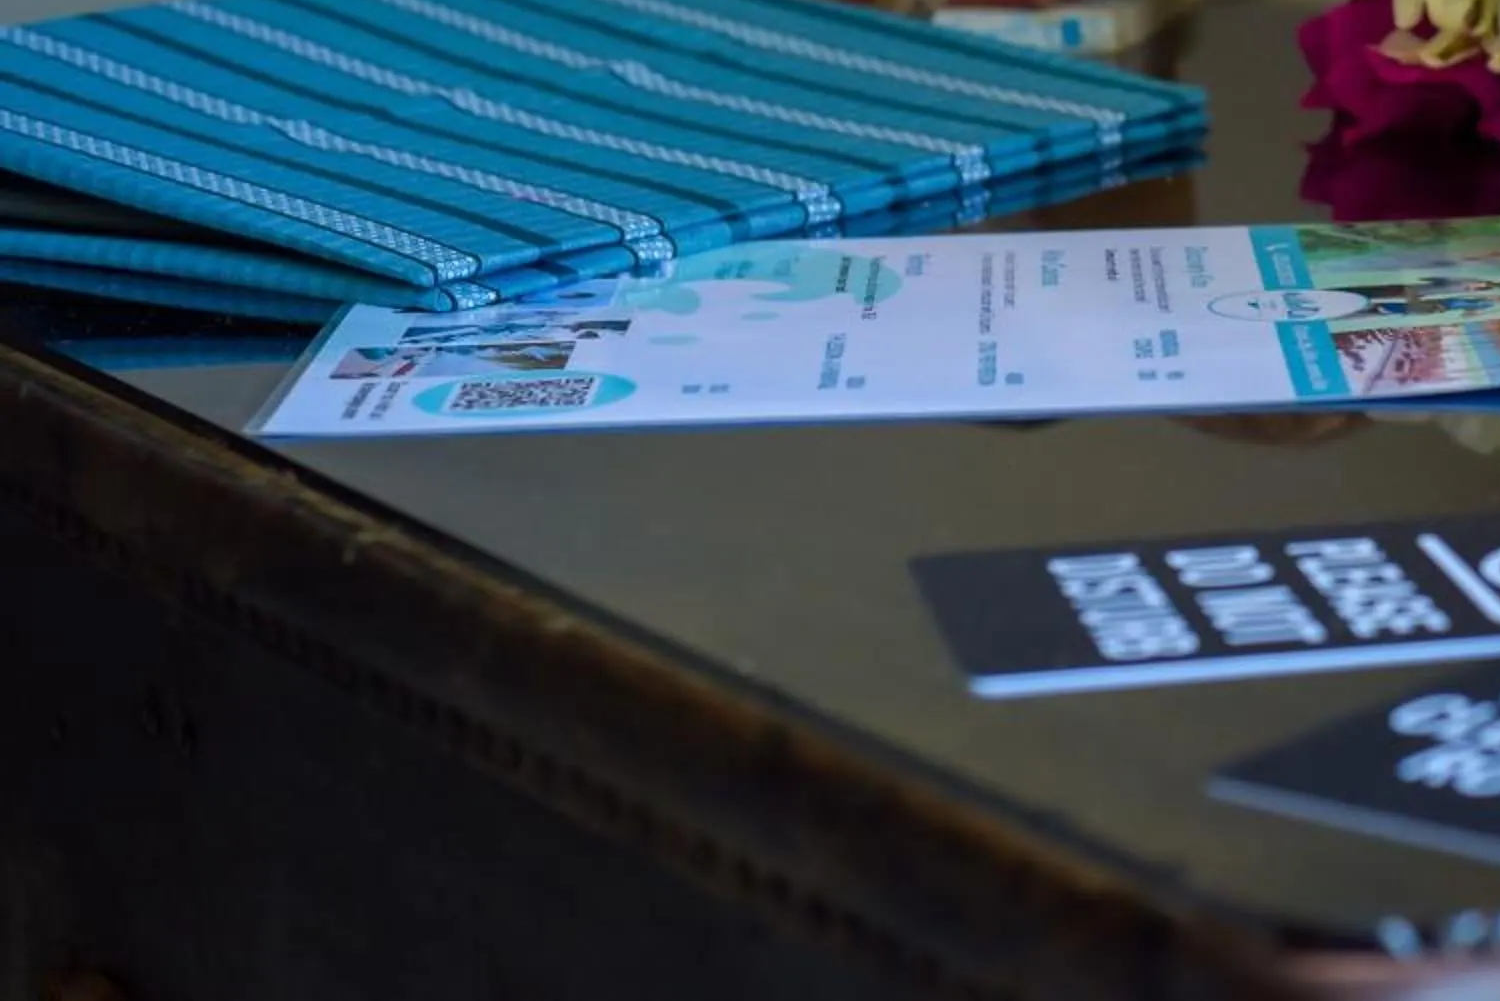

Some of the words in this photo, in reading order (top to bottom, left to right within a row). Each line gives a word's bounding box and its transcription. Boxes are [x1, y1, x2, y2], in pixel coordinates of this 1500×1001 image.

[1047, 552, 1199, 660] DISTURB
[1164, 545, 1275, 587] DO
[1284, 538, 1451, 638] PLEASE
[1195, 585, 1327, 646] NOT
